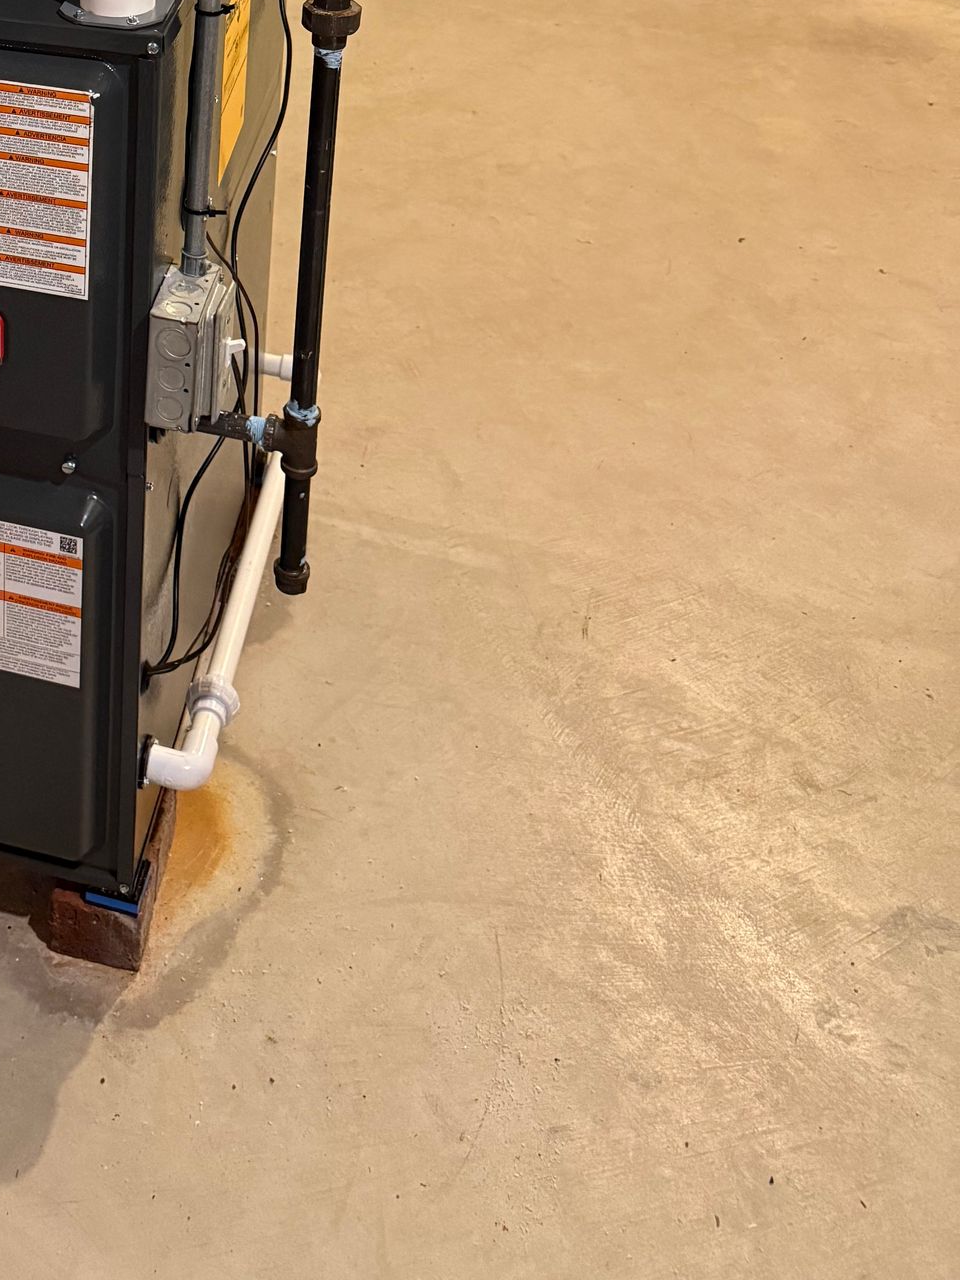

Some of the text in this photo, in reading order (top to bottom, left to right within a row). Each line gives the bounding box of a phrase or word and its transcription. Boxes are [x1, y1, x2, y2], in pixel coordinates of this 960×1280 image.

[26, 88, 55, 97] WARNING
[19, 108, 70, 121] AVERTISSEMENT
[23, 130, 65, 142] ADVERTENCIA
[15, 155, 44, 165] WARNING
[6, 191, 56, 204] AVERTISSEMENT
[14, 229, 43, 239] WARNING
[5, 255, 54, 269] AVERTISSEMENT
